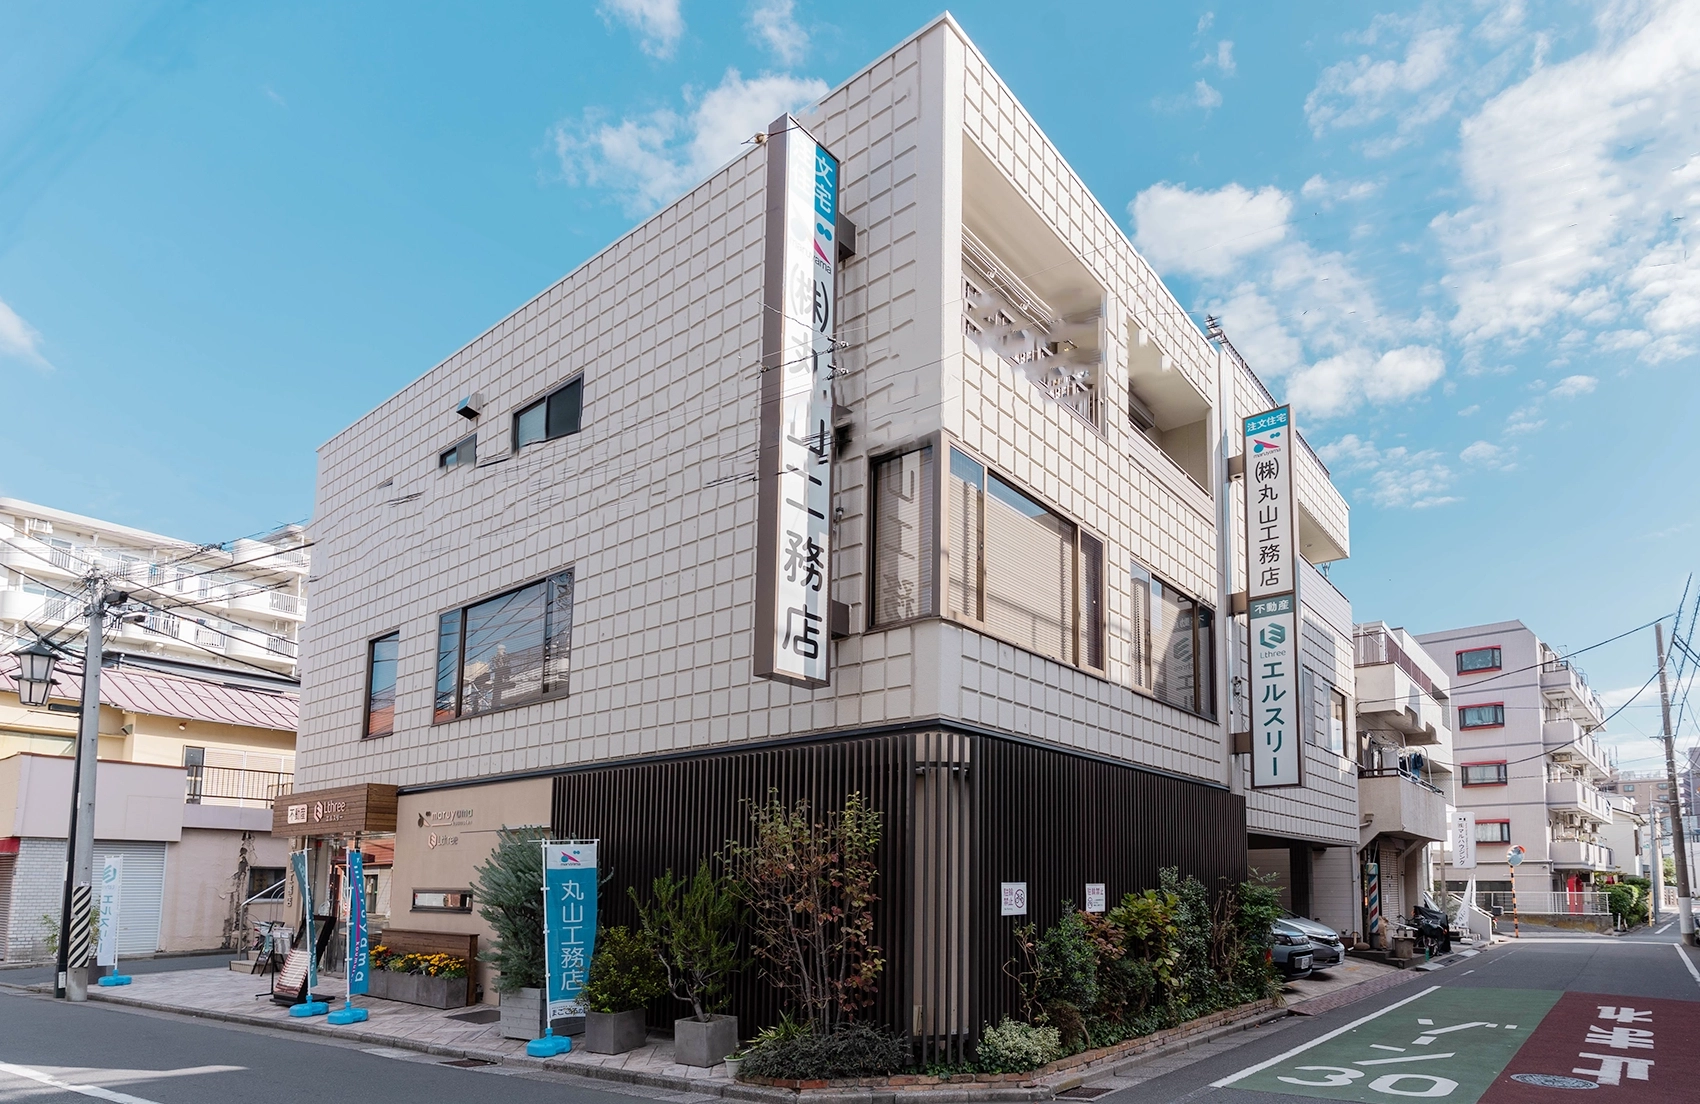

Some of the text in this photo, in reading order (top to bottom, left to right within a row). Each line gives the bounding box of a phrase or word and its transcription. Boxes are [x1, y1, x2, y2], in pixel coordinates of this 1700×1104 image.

[789, 237, 833, 275] maruyama
[1247, 413, 1287, 432] 注文住宅
[1253, 447, 1281, 459] maruyama
[1255, 456, 1280, 588] (株)丸山工務店
[1254, 599, 1289, 615] 不動産
[1260, 649, 1286, 659] Lthree
[1261, 661, 1287, 776] エルスリー
[324, 801, 346, 813] Lthree
[432, 809, 474, 821] maruyama
[561, 880, 584, 991] 丸山工務店
[1572, 1006, 1655, 1086] 止まれ
[1277, 1066, 1460, 1098] 30
